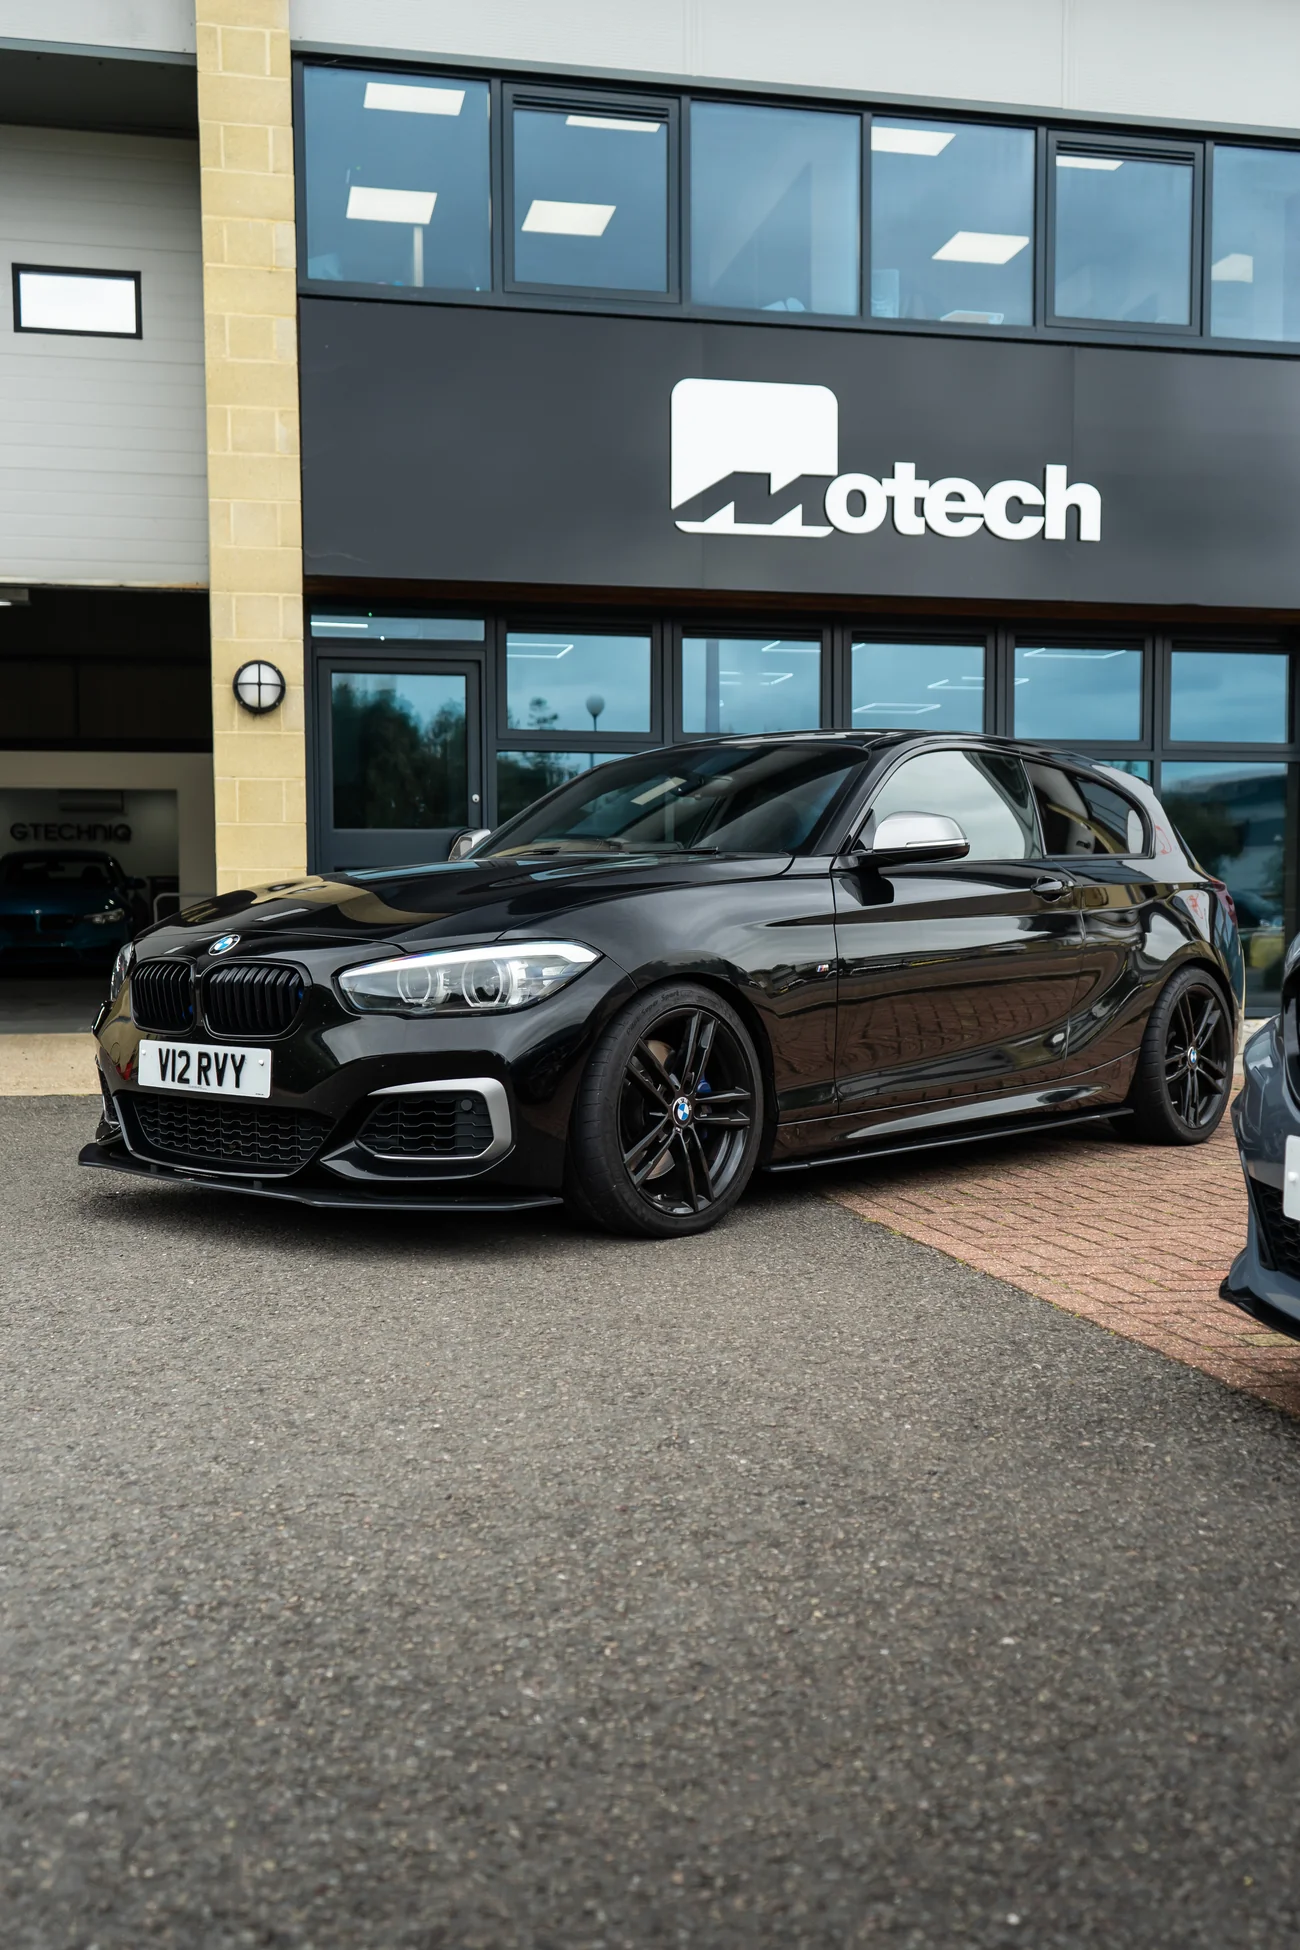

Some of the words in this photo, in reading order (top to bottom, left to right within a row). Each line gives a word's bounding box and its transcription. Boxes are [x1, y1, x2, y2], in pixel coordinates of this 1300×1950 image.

[10, 822, 132, 844] GTECHNIQ
[661, 989, 680, 1001] Sport
[158, 1047, 191, 1085] V12
[197, 1051, 246, 1089] RVY
